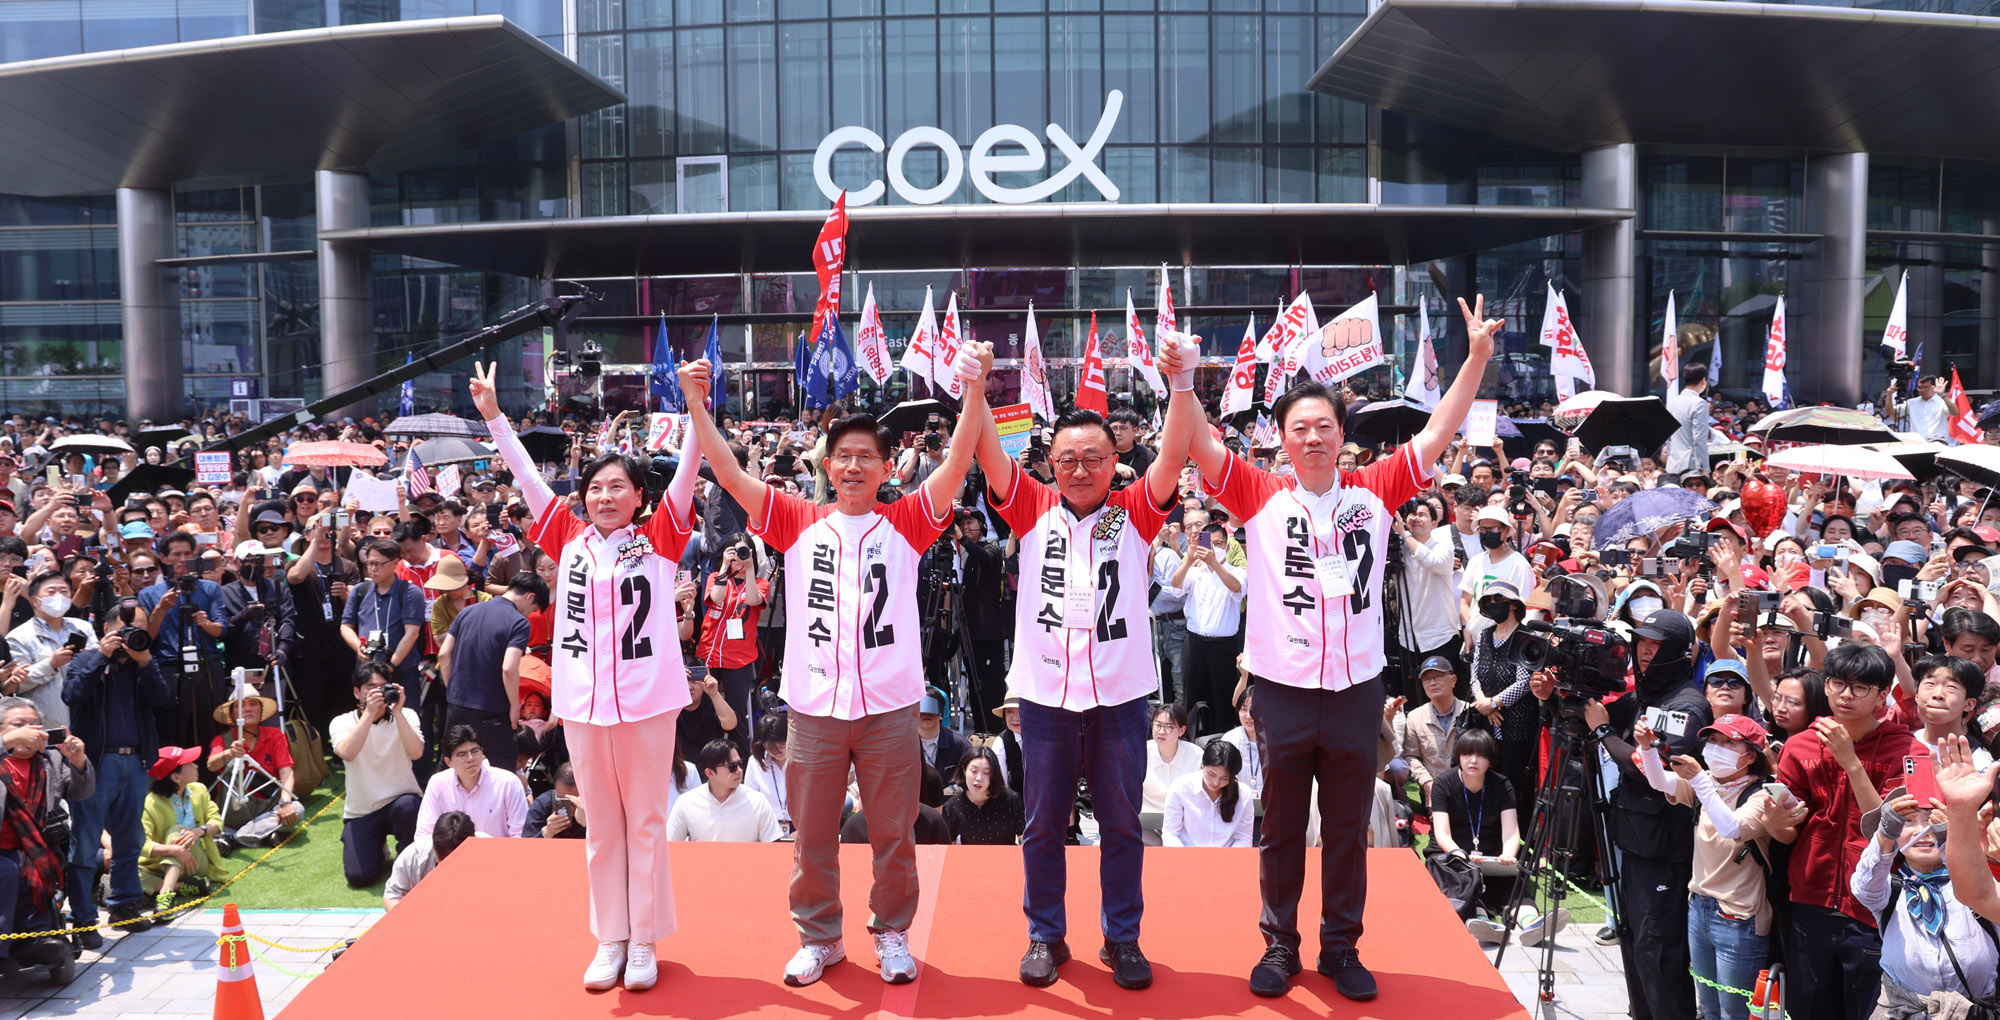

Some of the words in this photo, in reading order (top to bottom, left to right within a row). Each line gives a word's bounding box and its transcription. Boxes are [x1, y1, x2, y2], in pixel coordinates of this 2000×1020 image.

[813, 89, 1124, 207] coex
[198, 454, 228, 462] 대통령은
[652, 416, 673, 449] 2
[208, 473, 229, 481] 김문수
[561, 553, 590, 659] 김문수
[808, 543, 836, 648] 김문수
[863, 562, 895, 650] 2
[1037, 529, 1067, 633] 김문수
[1096, 559, 1128, 643] 2
[1283, 516, 1316, 616] 김문수
[1343, 529, 1375, 615] 2
[620, 574, 653, 661] 2
[1800, 759, 1820, 769] MAY
